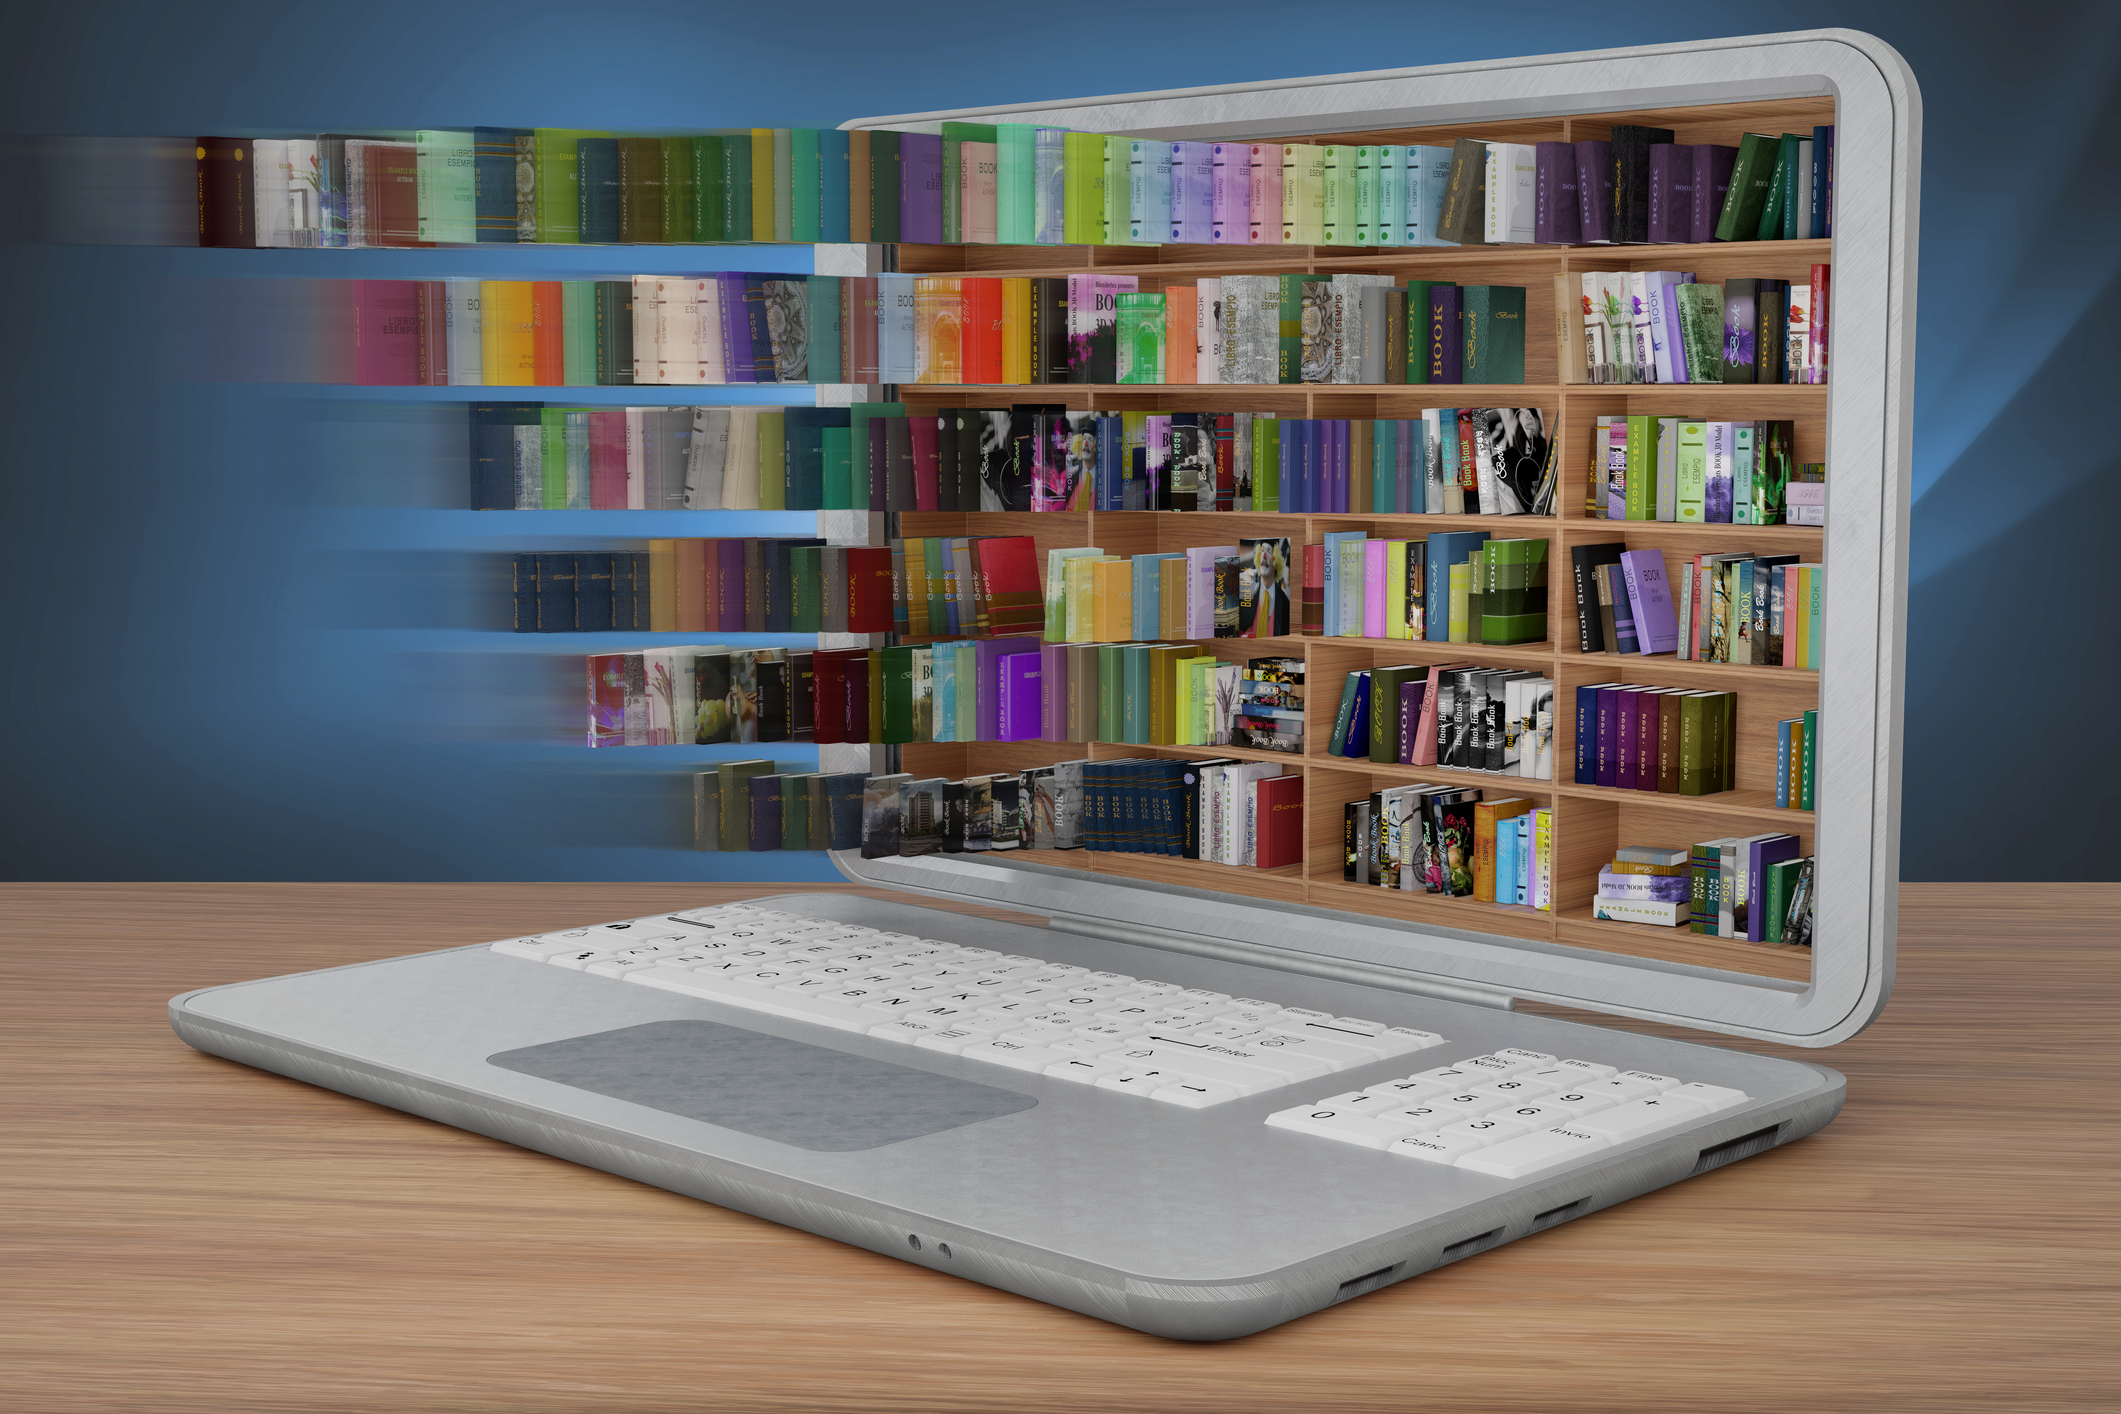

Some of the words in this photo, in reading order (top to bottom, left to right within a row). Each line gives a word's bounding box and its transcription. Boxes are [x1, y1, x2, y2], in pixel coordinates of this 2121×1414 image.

[978, 162, 998, 174] BOOK
[1580, 165, 1590, 226] BOOK
[1726, 158, 1744, 213] BOOK
[1766, 160, 1784, 213] BOOK
[1280, 276, 1288, 304] BOOK
[1227, 294, 1236, 338] ESEMPIO
[1335, 294, 1344, 338] ESEMPIO
[1495, 310, 1519, 320] Book
[1650, 290, 1660, 324] BOOK
[750, 312, 758, 340] BOOK
[1728, 304, 1740, 368] Book
[1433, 304, 1444, 377] BOOK
[1467, 309, 1477, 369] Book
[1226, 340, 1236, 368] LIBRO
[1280, 350, 1288, 378] BOOK
[1461, 438, 1470, 462] Book
[1463, 461, 1472, 486] Book
[1240, 566, 1252, 588] Book
[1624, 568, 1638, 600] BOOK
[1643, 570, 1662, 582] BOOK
[1240, 588, 1252, 608] Book
[1430, 560, 1438, 625] Book
[1756, 584, 1765, 606] Book
[1812, 586, 1820, 616] BOOK
[1740, 590, 1751, 623] BOOK
[1755, 606, 1764, 632] Book
[1422, 682, 1435, 714] BOOK
[1438, 700, 1447, 722] Book
[1454, 700, 1463, 723] Book
[1470, 702, 1479, 724] Book
[1438, 722, 1446, 744] Book
[1454, 722, 1462, 746] Book
[1470, 724, 1478, 748] Book
[1054, 794, 1065, 828] BOOK
[1162, 799, 1172, 822] BOOK
[1370, 812, 1380, 838] Book
[1402, 821, 1410, 842] Book
[1401, 843, 1410, 865] Book
[1693, 876, 1704, 900] BOOK
[1736, 868, 1746, 906] BOOK
[704, 942, 726, 950] S
[770, 938, 799, 946] W
[712, 962, 741, 970] X
[848, 953, 872, 961] R
[756, 970, 780, 979] C
[864, 975, 891, 983] H
[842, 989, 868, 997] B
[882, 998, 910, 1006] N
[926, 1007, 958, 1016] M
[1002, 1002, 1020, 1010] L
[1206, 1045, 1256, 1058] Enter
[1507, 1049, 1548, 1060] Canc
[1438, 1069, 1464, 1077] 7
[1468, 1059, 1506, 1070] Num
[1497, 1082, 1522, 1090] 8
[1626, 1070, 1663, 1082] Fine
[1452, 1094, 1479, 1103] 5
[1560, 1094, 1584, 1102] 9
[1310, 1110, 1336, 1120] 0
[1405, 1107, 1433, 1117] 2
[1516, 1107, 1542, 1116] 6
[1470, 1120, 1496, 1130] 3
[1550, 1127, 1592, 1140] Invio
[1401, 1137, 1446, 1151] Canc
